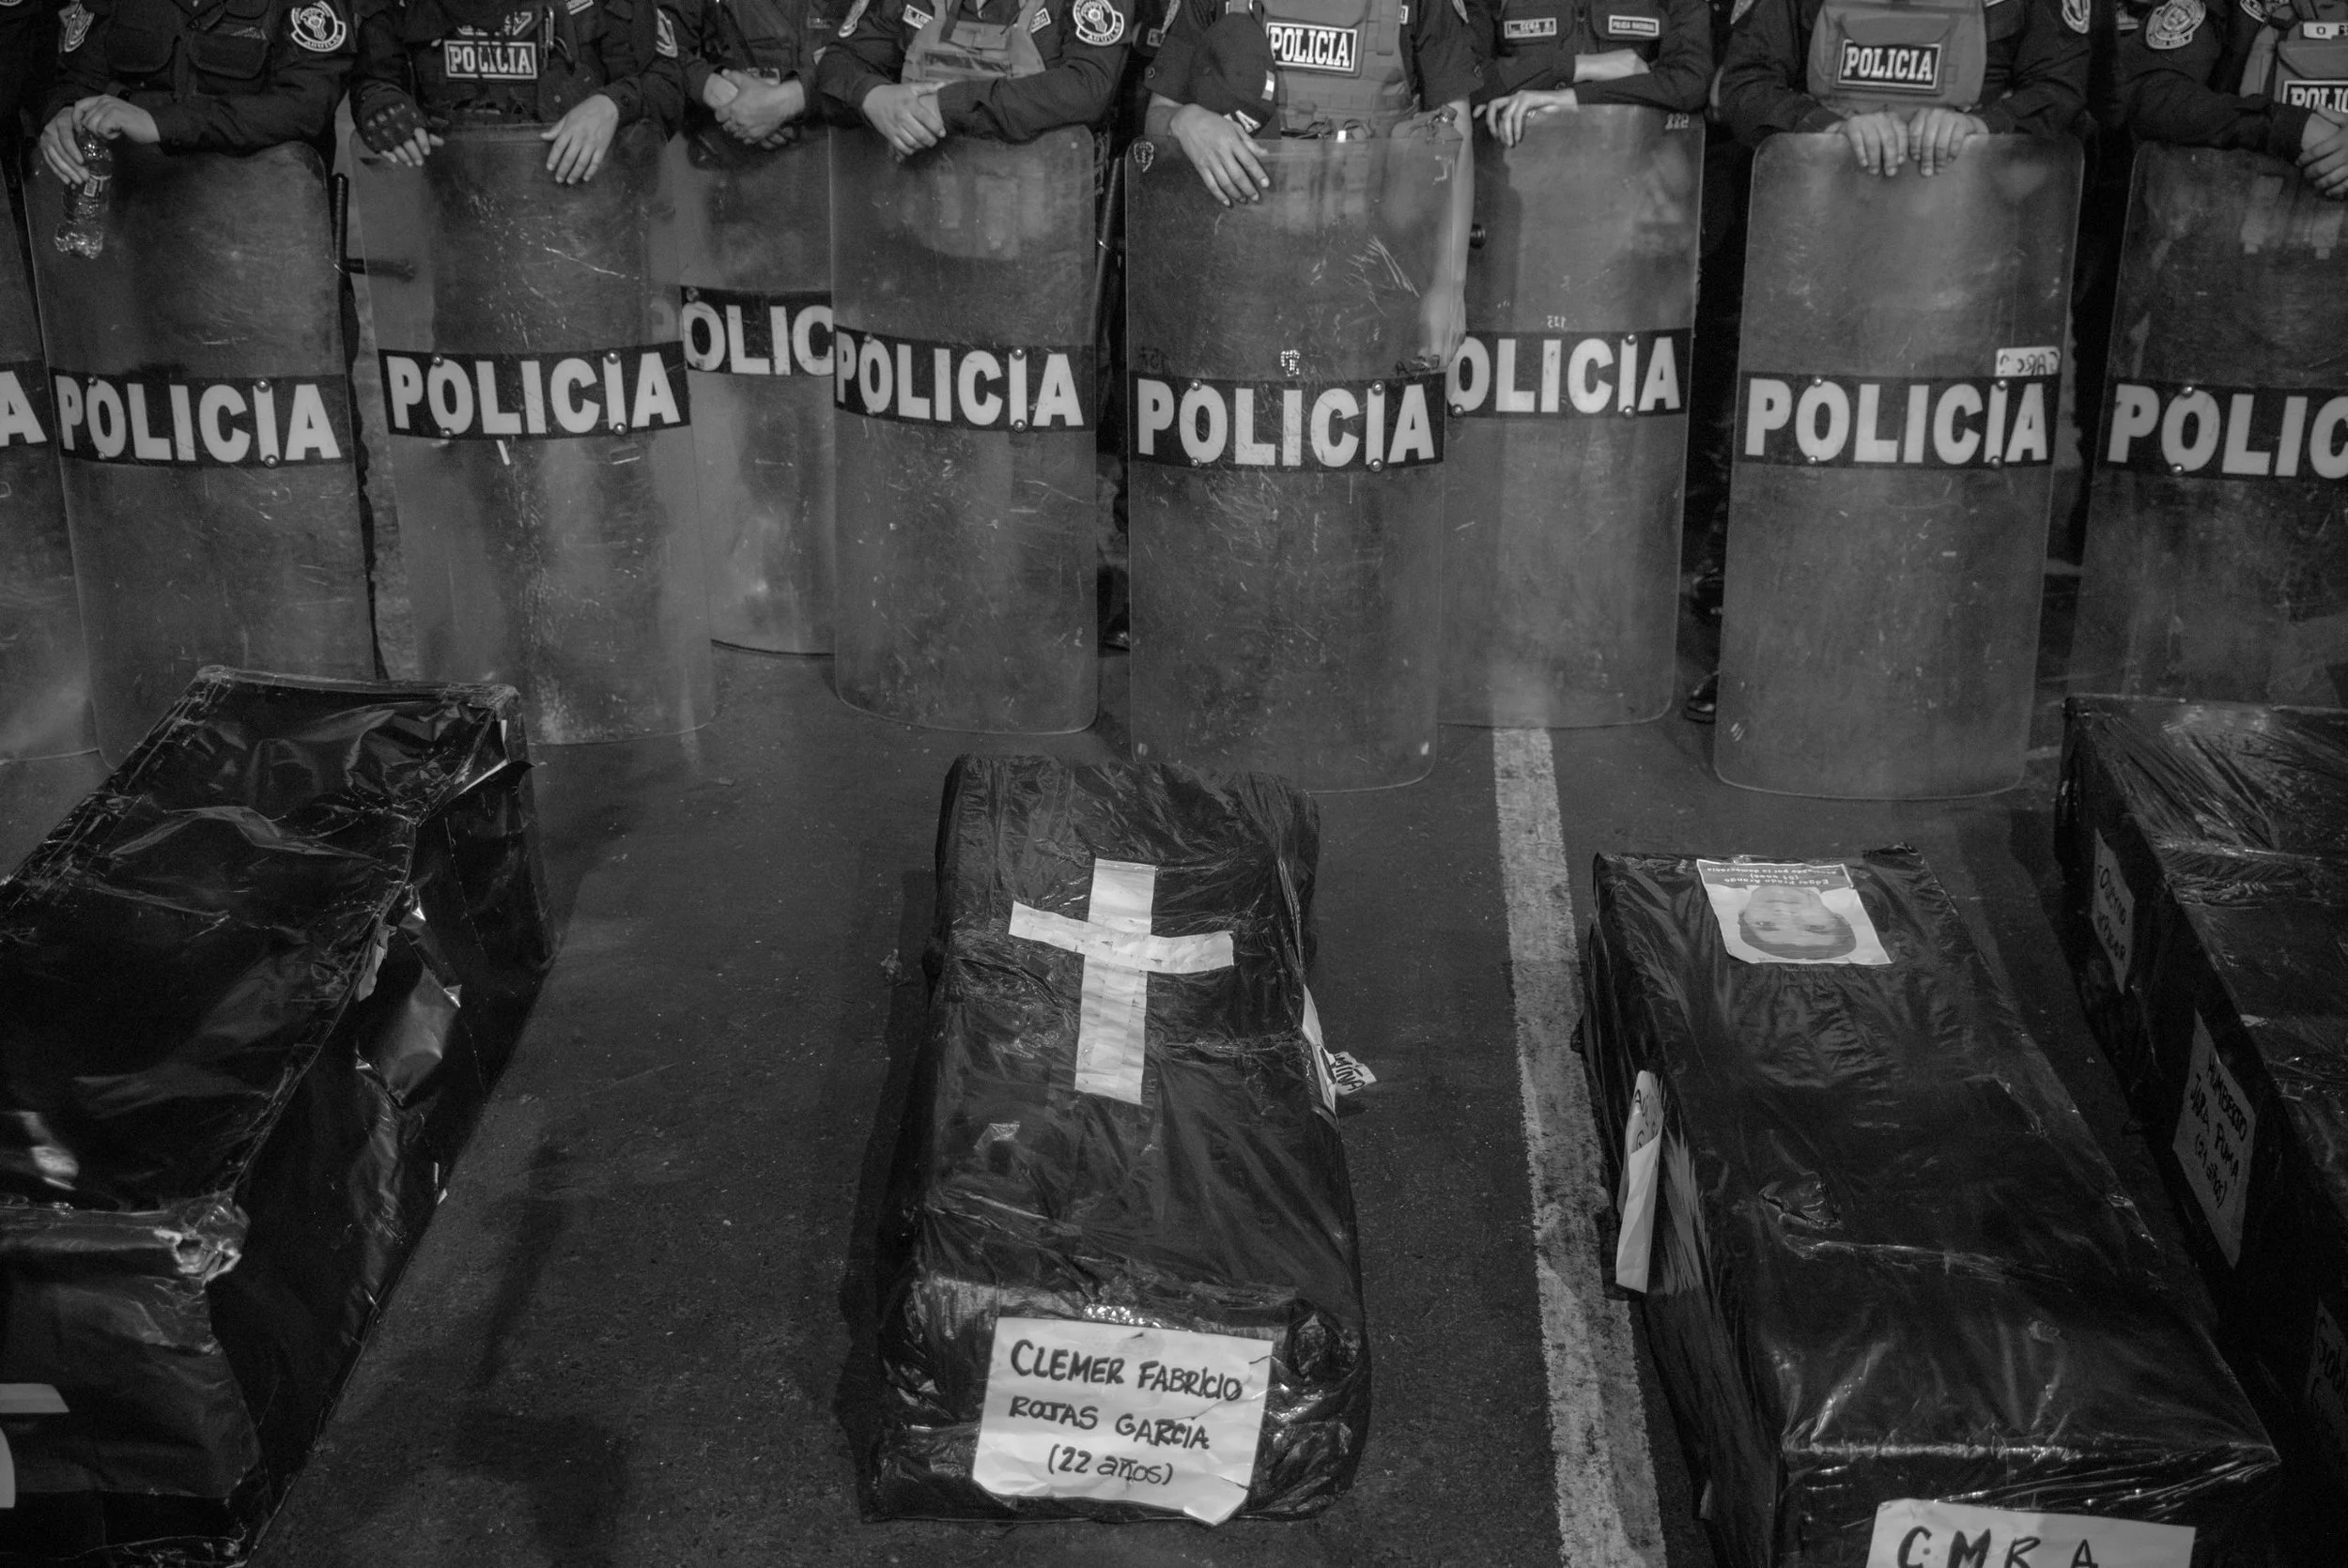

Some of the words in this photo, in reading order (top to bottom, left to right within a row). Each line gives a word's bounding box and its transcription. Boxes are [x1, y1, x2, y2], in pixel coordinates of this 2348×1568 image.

[449, 47, 533, 73] POLICIA
[1270, 26, 1351, 68] POLICIA
[1843, 46, 1933, 81] POLICIA
[682, 301, 834, 376] OLIC
[1445, 336, 1679, 413] OLICIA
[387, 352, 681, 434] POLICIA
[837, 332, 1084, 426] POLICIA
[56, 377, 341, 462] POLICIA
[1138, 379, 1435, 467] POLICIA
[1746, 377, 2047, 464] POLICIA
[2109, 384, 2348, 478] POLIC
[1011, 1339, 1125, 1385] CLEMER
[1009, 1395, 1099, 1430] ROJAS
[1115, 1413, 1210, 1450] GARCIA
[1047, 1443, 1092, 1475] (22
